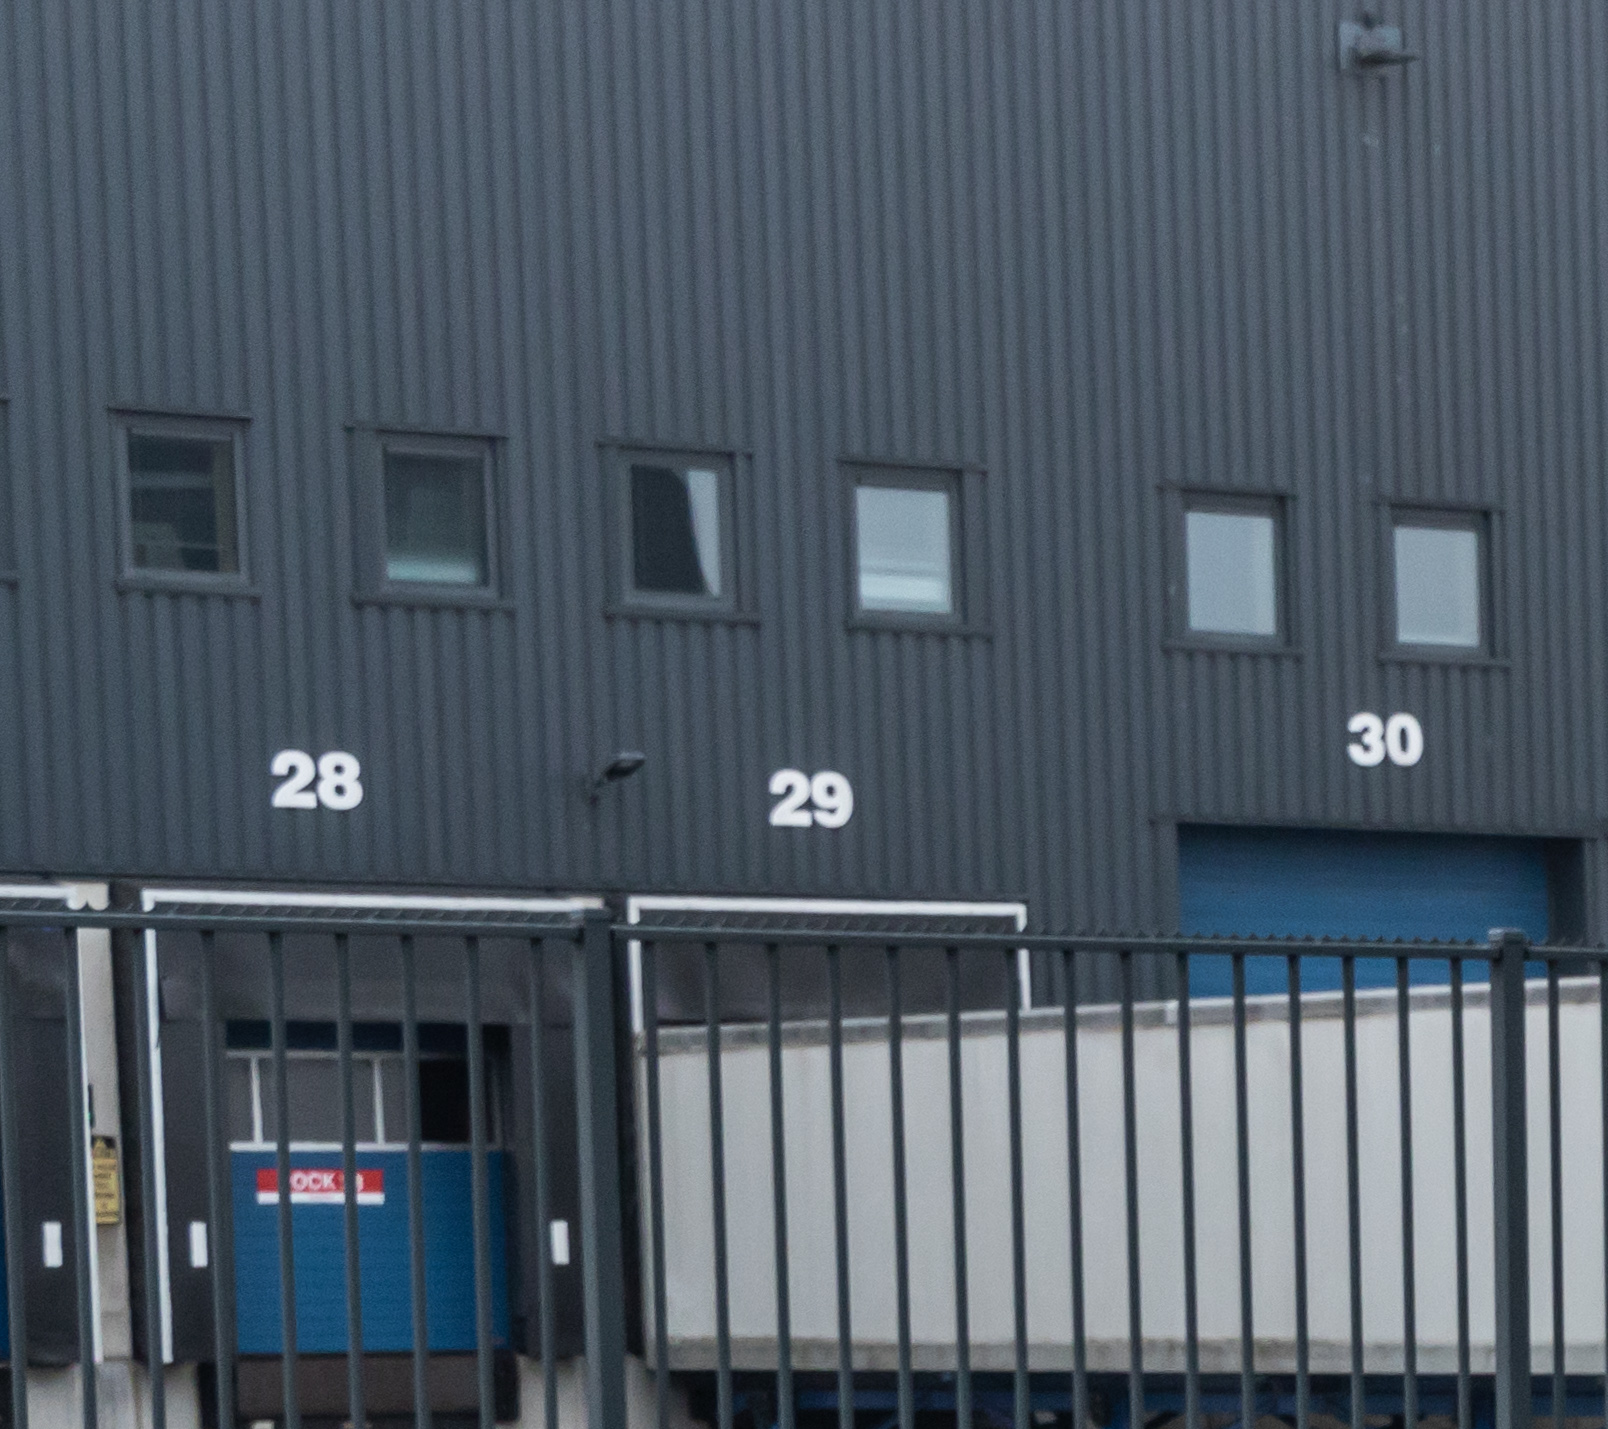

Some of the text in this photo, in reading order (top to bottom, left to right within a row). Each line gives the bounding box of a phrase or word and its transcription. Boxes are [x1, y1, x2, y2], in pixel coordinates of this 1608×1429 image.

[1347, 712, 1423, 767] 30
[271, 749, 363, 810] 28
[768, 769, 853, 828] 29
[279, 1172, 337, 1191] OCK
